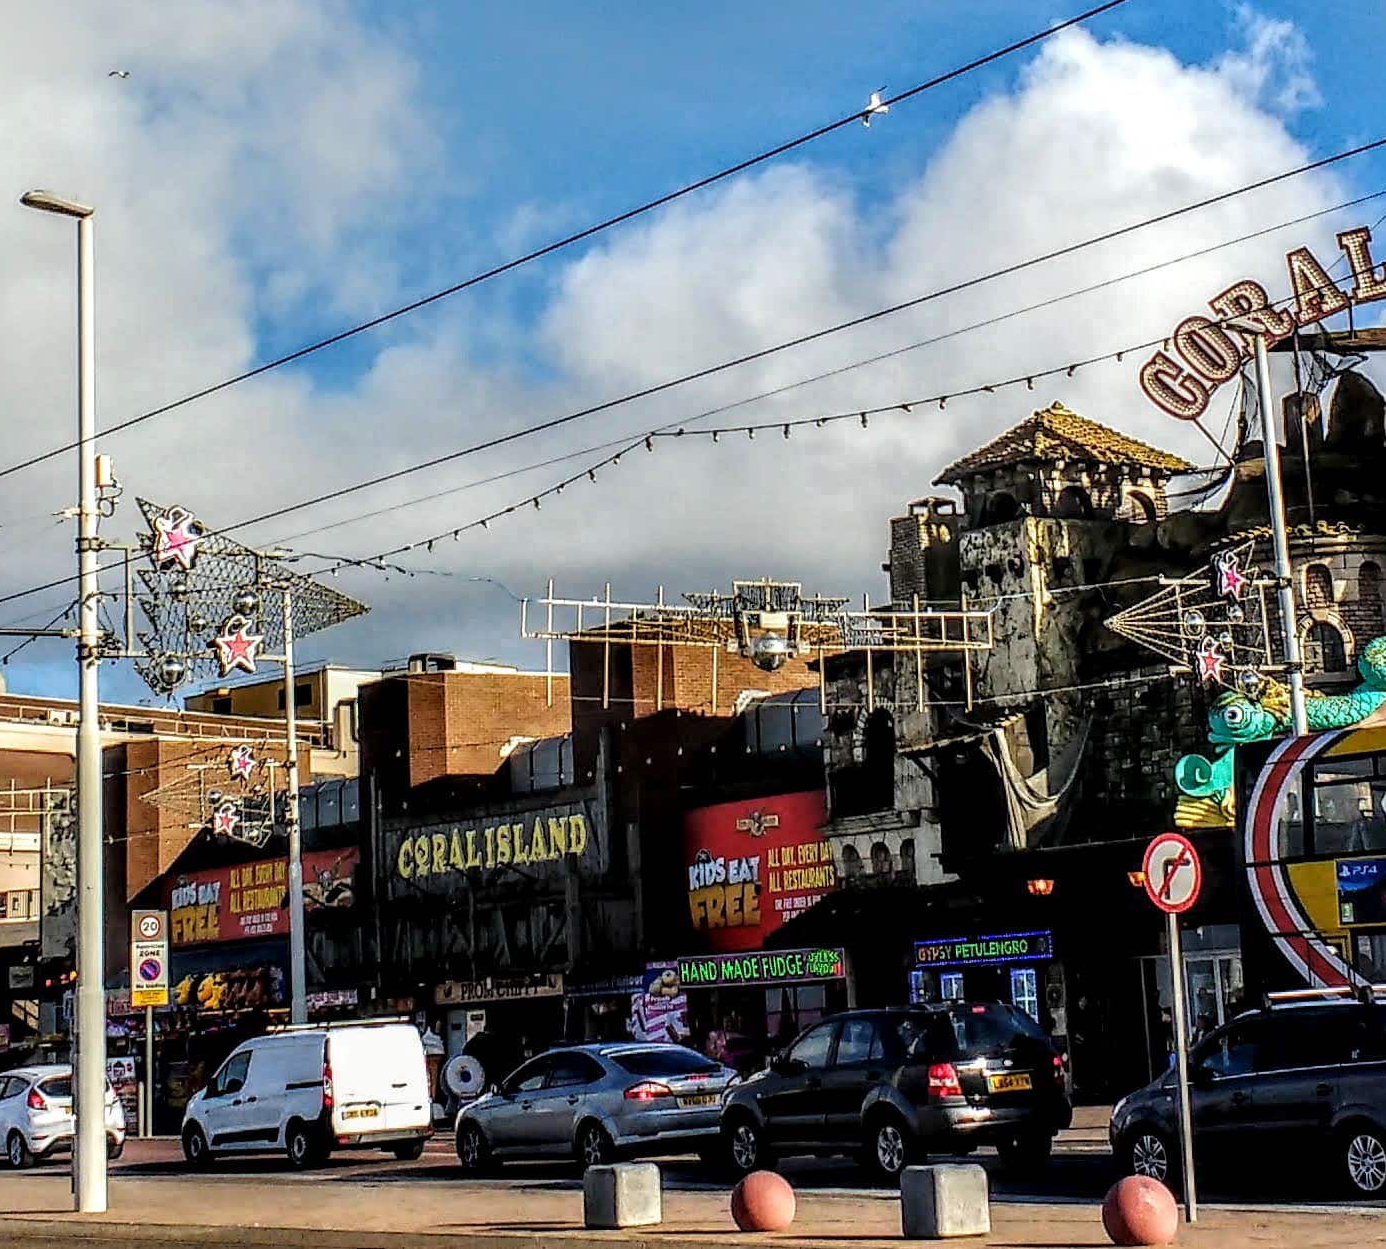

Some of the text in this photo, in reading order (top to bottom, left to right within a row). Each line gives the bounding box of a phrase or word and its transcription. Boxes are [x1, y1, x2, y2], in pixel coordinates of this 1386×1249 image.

[398, 813, 589, 879] CORAL ISLAND
[768, 847, 780, 868] ALL
[798, 843, 819, 864] EVERY
[819, 841, 834, 862] DAY
[688, 856, 760, 891] KIDS EAT
[768, 864, 836, 893] ALL RESTAURANTS
[1352, 864, 1378, 876] PS4
[688, 883, 762, 928] FREE
[142, 921, 158, 932] 20
[171, 904, 221, 944] FREE
[139, 949, 160, 957] ZONE
[917, 939, 1029, 962] GYPSY PETULENGRO
[680, 959, 718, 983] HAND
[721, 957, 760, 981] MADE
[762, 954, 804, 979] FUDGE
